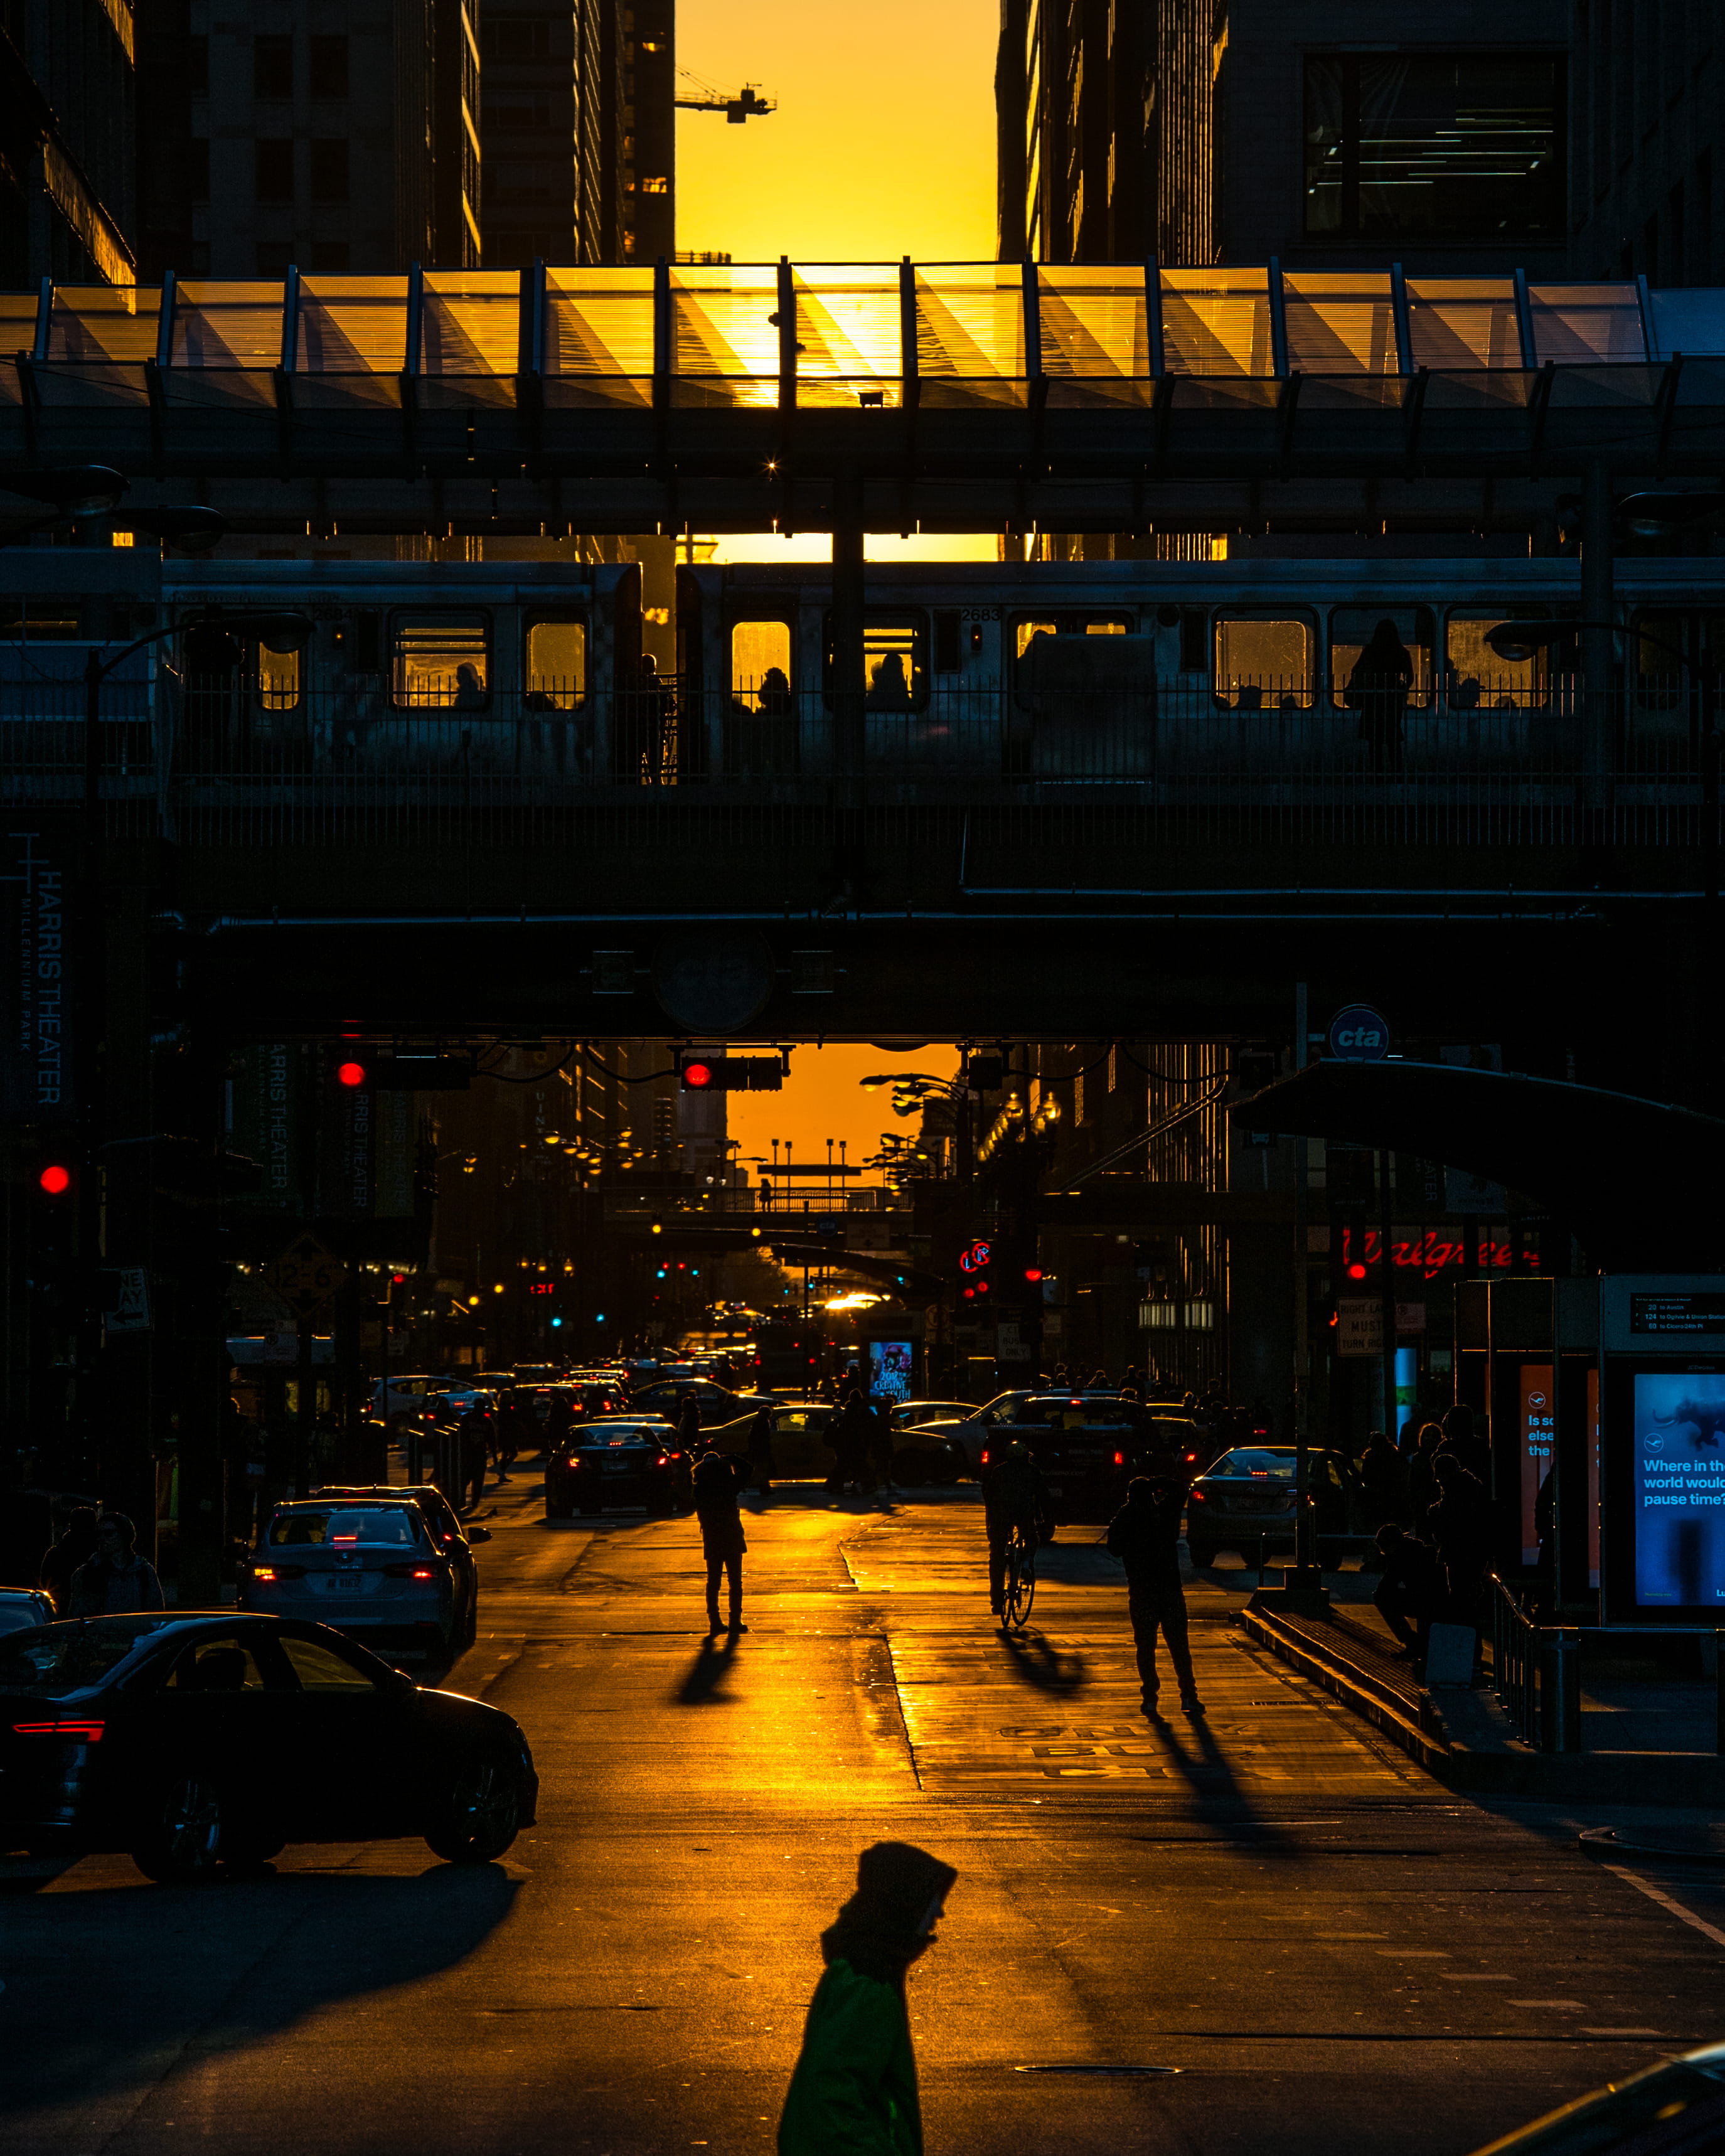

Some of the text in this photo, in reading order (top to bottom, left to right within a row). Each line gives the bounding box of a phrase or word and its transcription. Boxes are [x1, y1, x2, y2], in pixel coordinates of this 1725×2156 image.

[314, 608, 352, 621] 2684
[963, 609, 1000, 621] 2683
[20, 898, 31, 1052] MILLENNIUM PARK
[38, 871, 61, 1104] HARRIS THEATER
[1338, 1027, 1381, 1047] cta
[269, 1043, 288, 1189] ARRIS THEATER
[353, 1094, 369, 1208] RRIS THEATER
[1424, 1164, 1438, 1202] ATER
[1343, 1229, 1540, 1279] Walgrees
[121, 1273, 141, 1287] NE
[120, 1289, 142, 1306] AY
[1341, 1303, 1385, 1313] RIGHT LA
[1352, 1320, 1381, 1331] MUST
[1342, 1339, 1382, 1348] TURN RIG
[1529, 1414, 1540, 1426] Is
[1529, 1430, 1555, 1441] else
[1528, 1445, 1551, 1456] the
[1644, 1460, 1725, 1471] Where in th
[1644, 1476, 1683, 1488] world
[1644, 1496, 1687, 1507] pause
